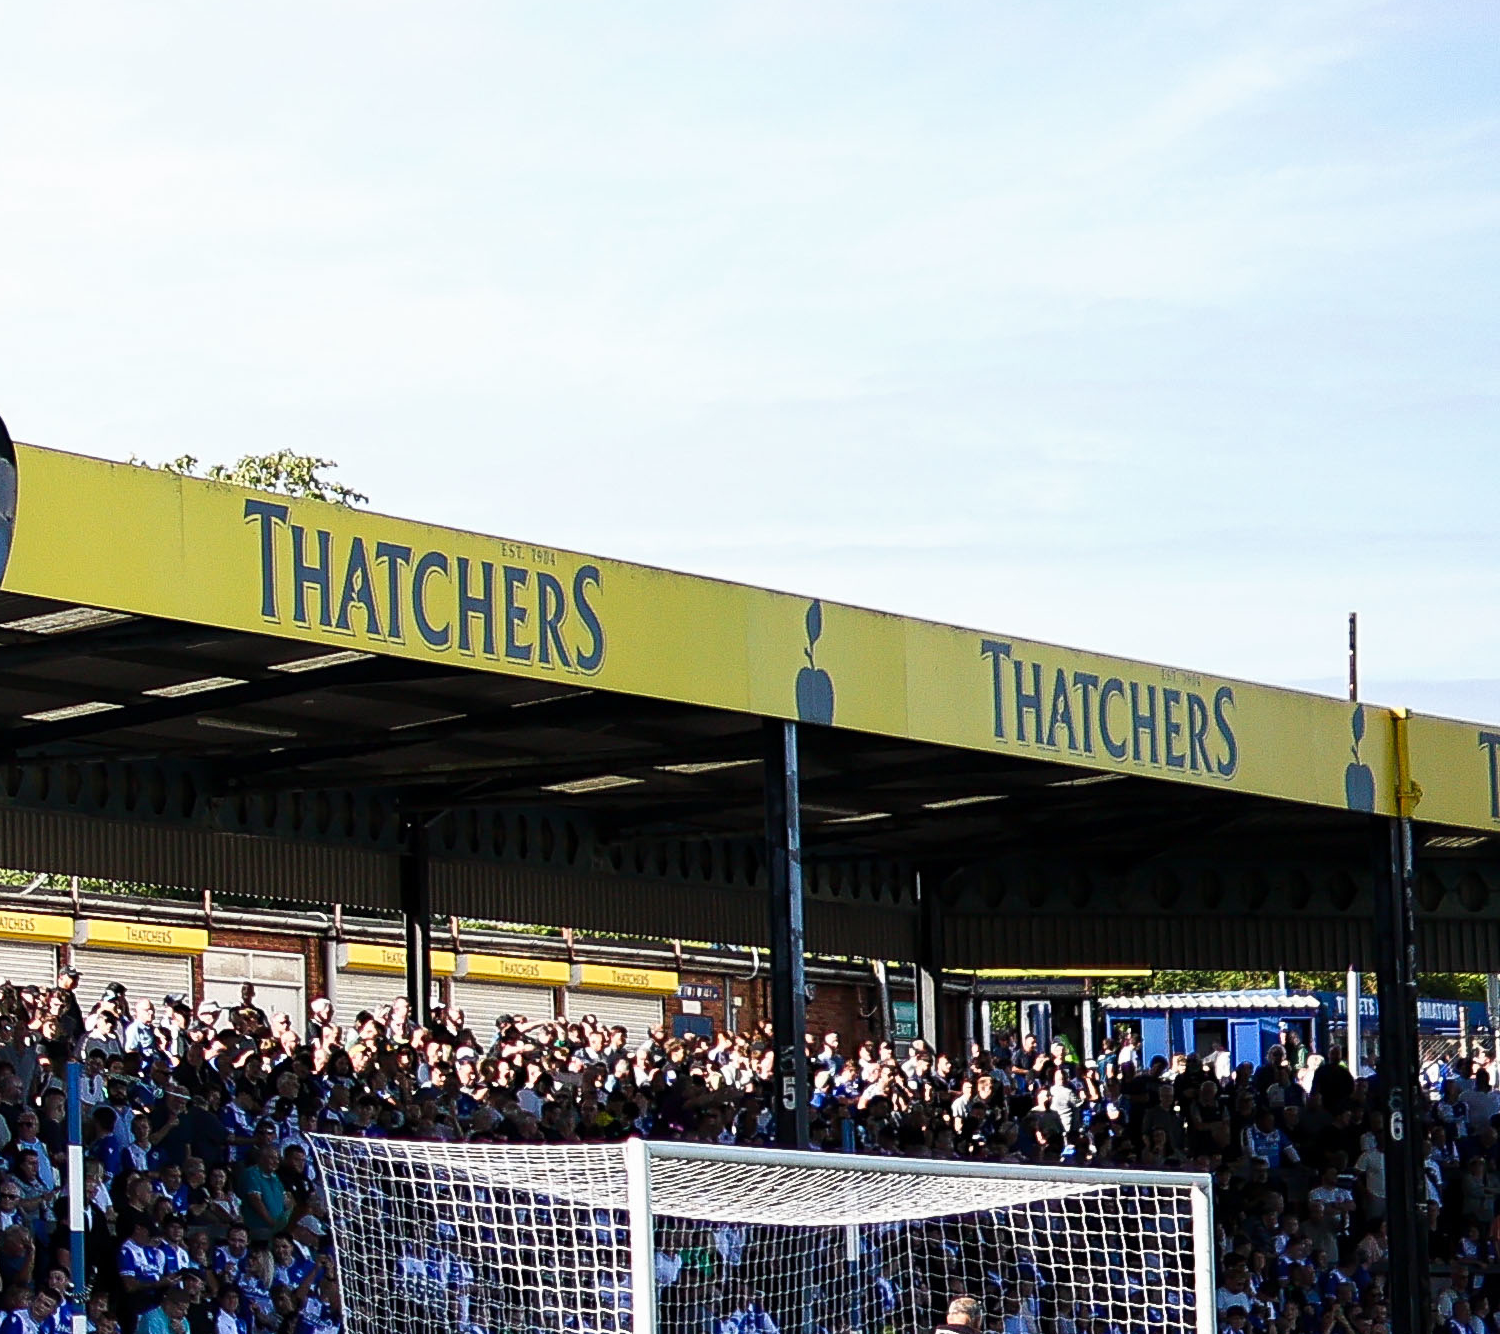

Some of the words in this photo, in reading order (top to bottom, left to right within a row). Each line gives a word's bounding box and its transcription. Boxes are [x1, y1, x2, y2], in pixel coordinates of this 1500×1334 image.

[243, 498, 605, 678] THATCHERS
[980, 638, 1238, 781] THATCHERS
[125, 925, 172, 945] THATCHERS
[381, 950, 406, 965] THATC
[500, 959, 540, 977] THATCHERS
[611, 969, 649, 986] THATCHERS
[782, 1075, 797, 1111] 5
[1390, 1111, 1403, 1141] 6
